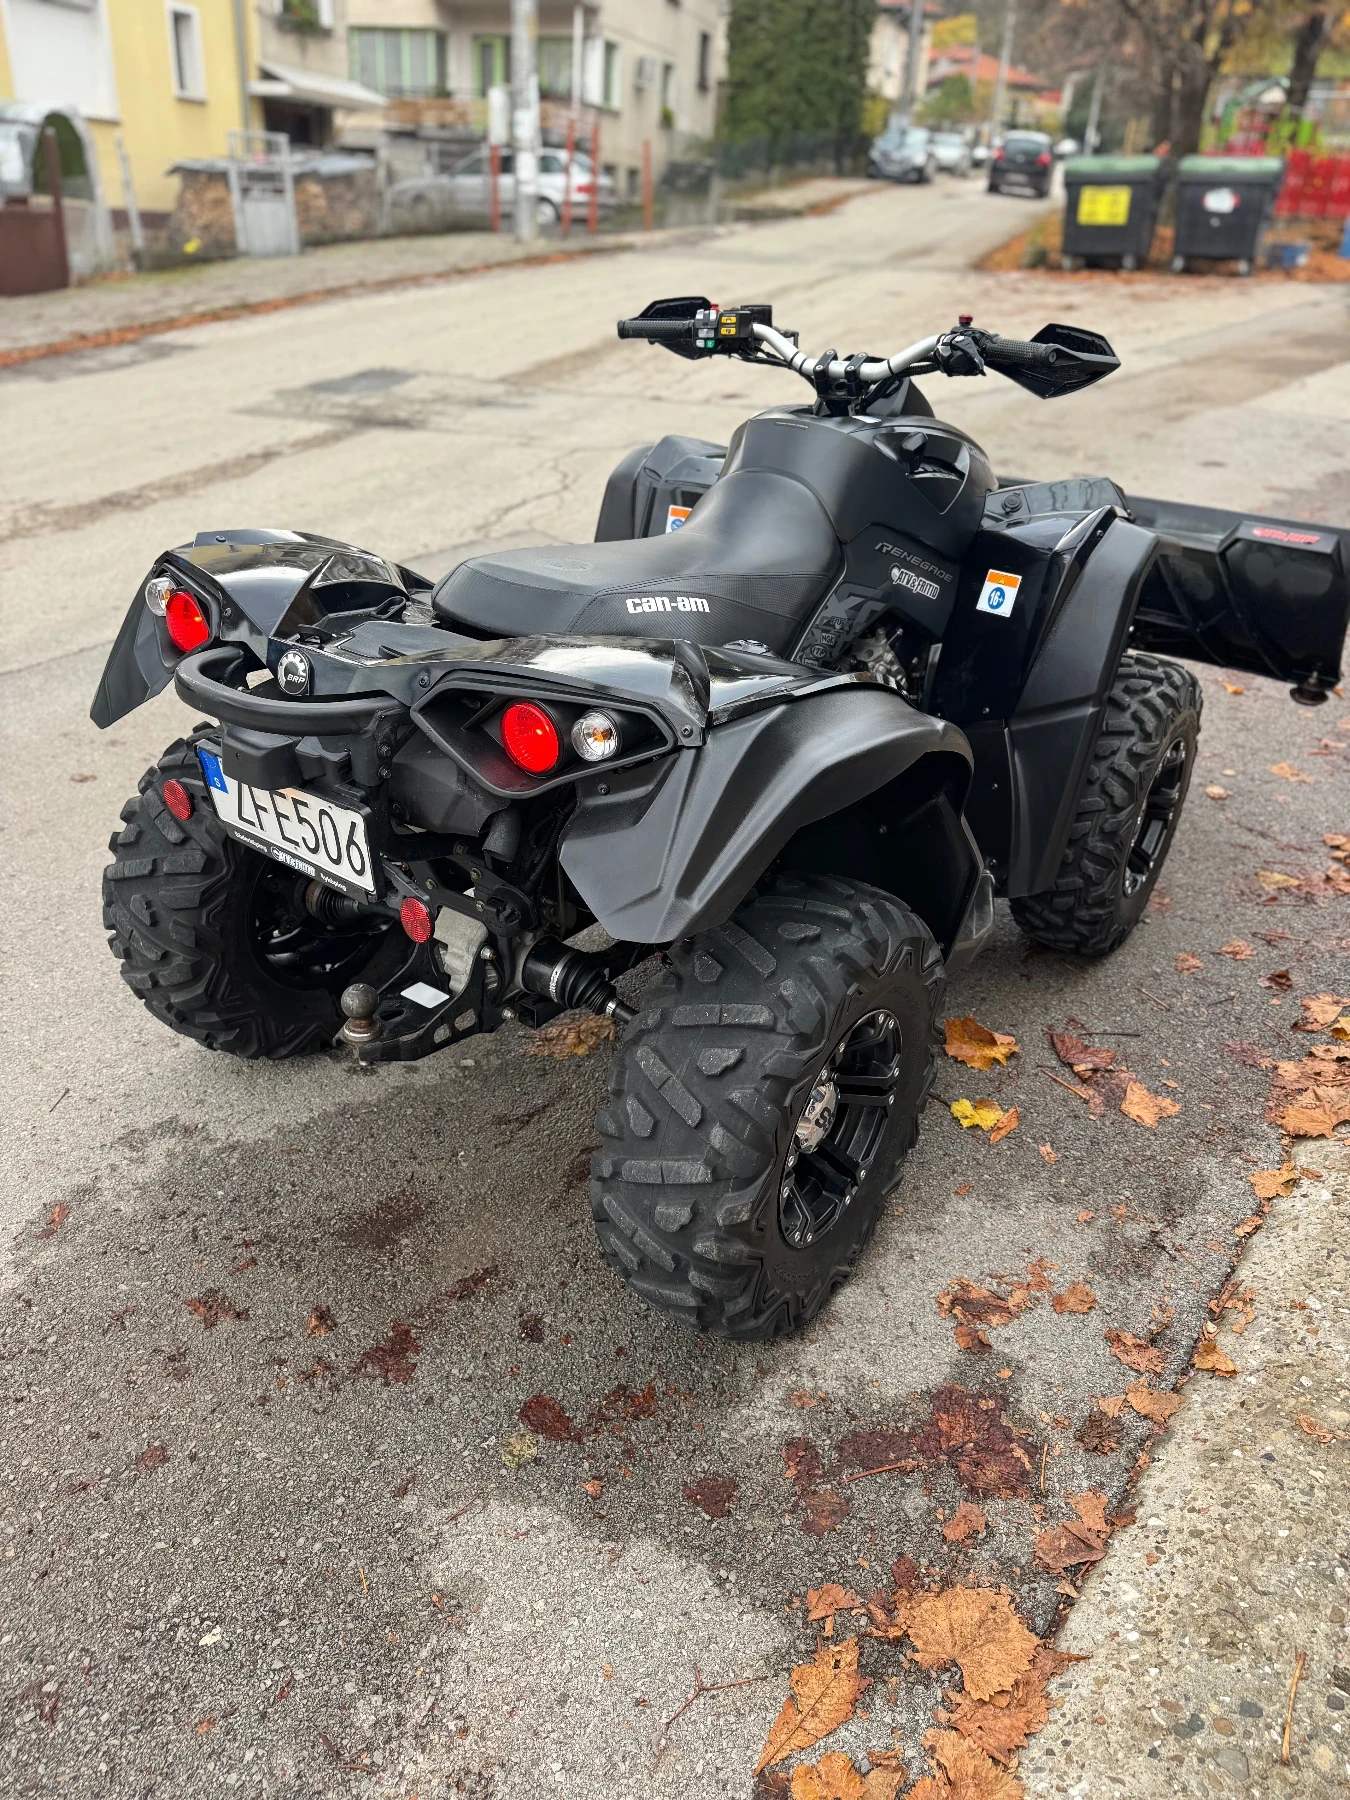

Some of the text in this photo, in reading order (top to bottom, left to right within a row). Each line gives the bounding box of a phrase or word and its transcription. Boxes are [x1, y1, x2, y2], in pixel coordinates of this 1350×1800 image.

[875, 541, 953, 582] RENEGADE
[893, 569, 940, 600] ATV&FRITID
[626, 596, 711, 614] can-am
[989, 591, 1003, 606] 16+
[287, 673, 305, 684] BRP
[213, 776, 221, 788] S
